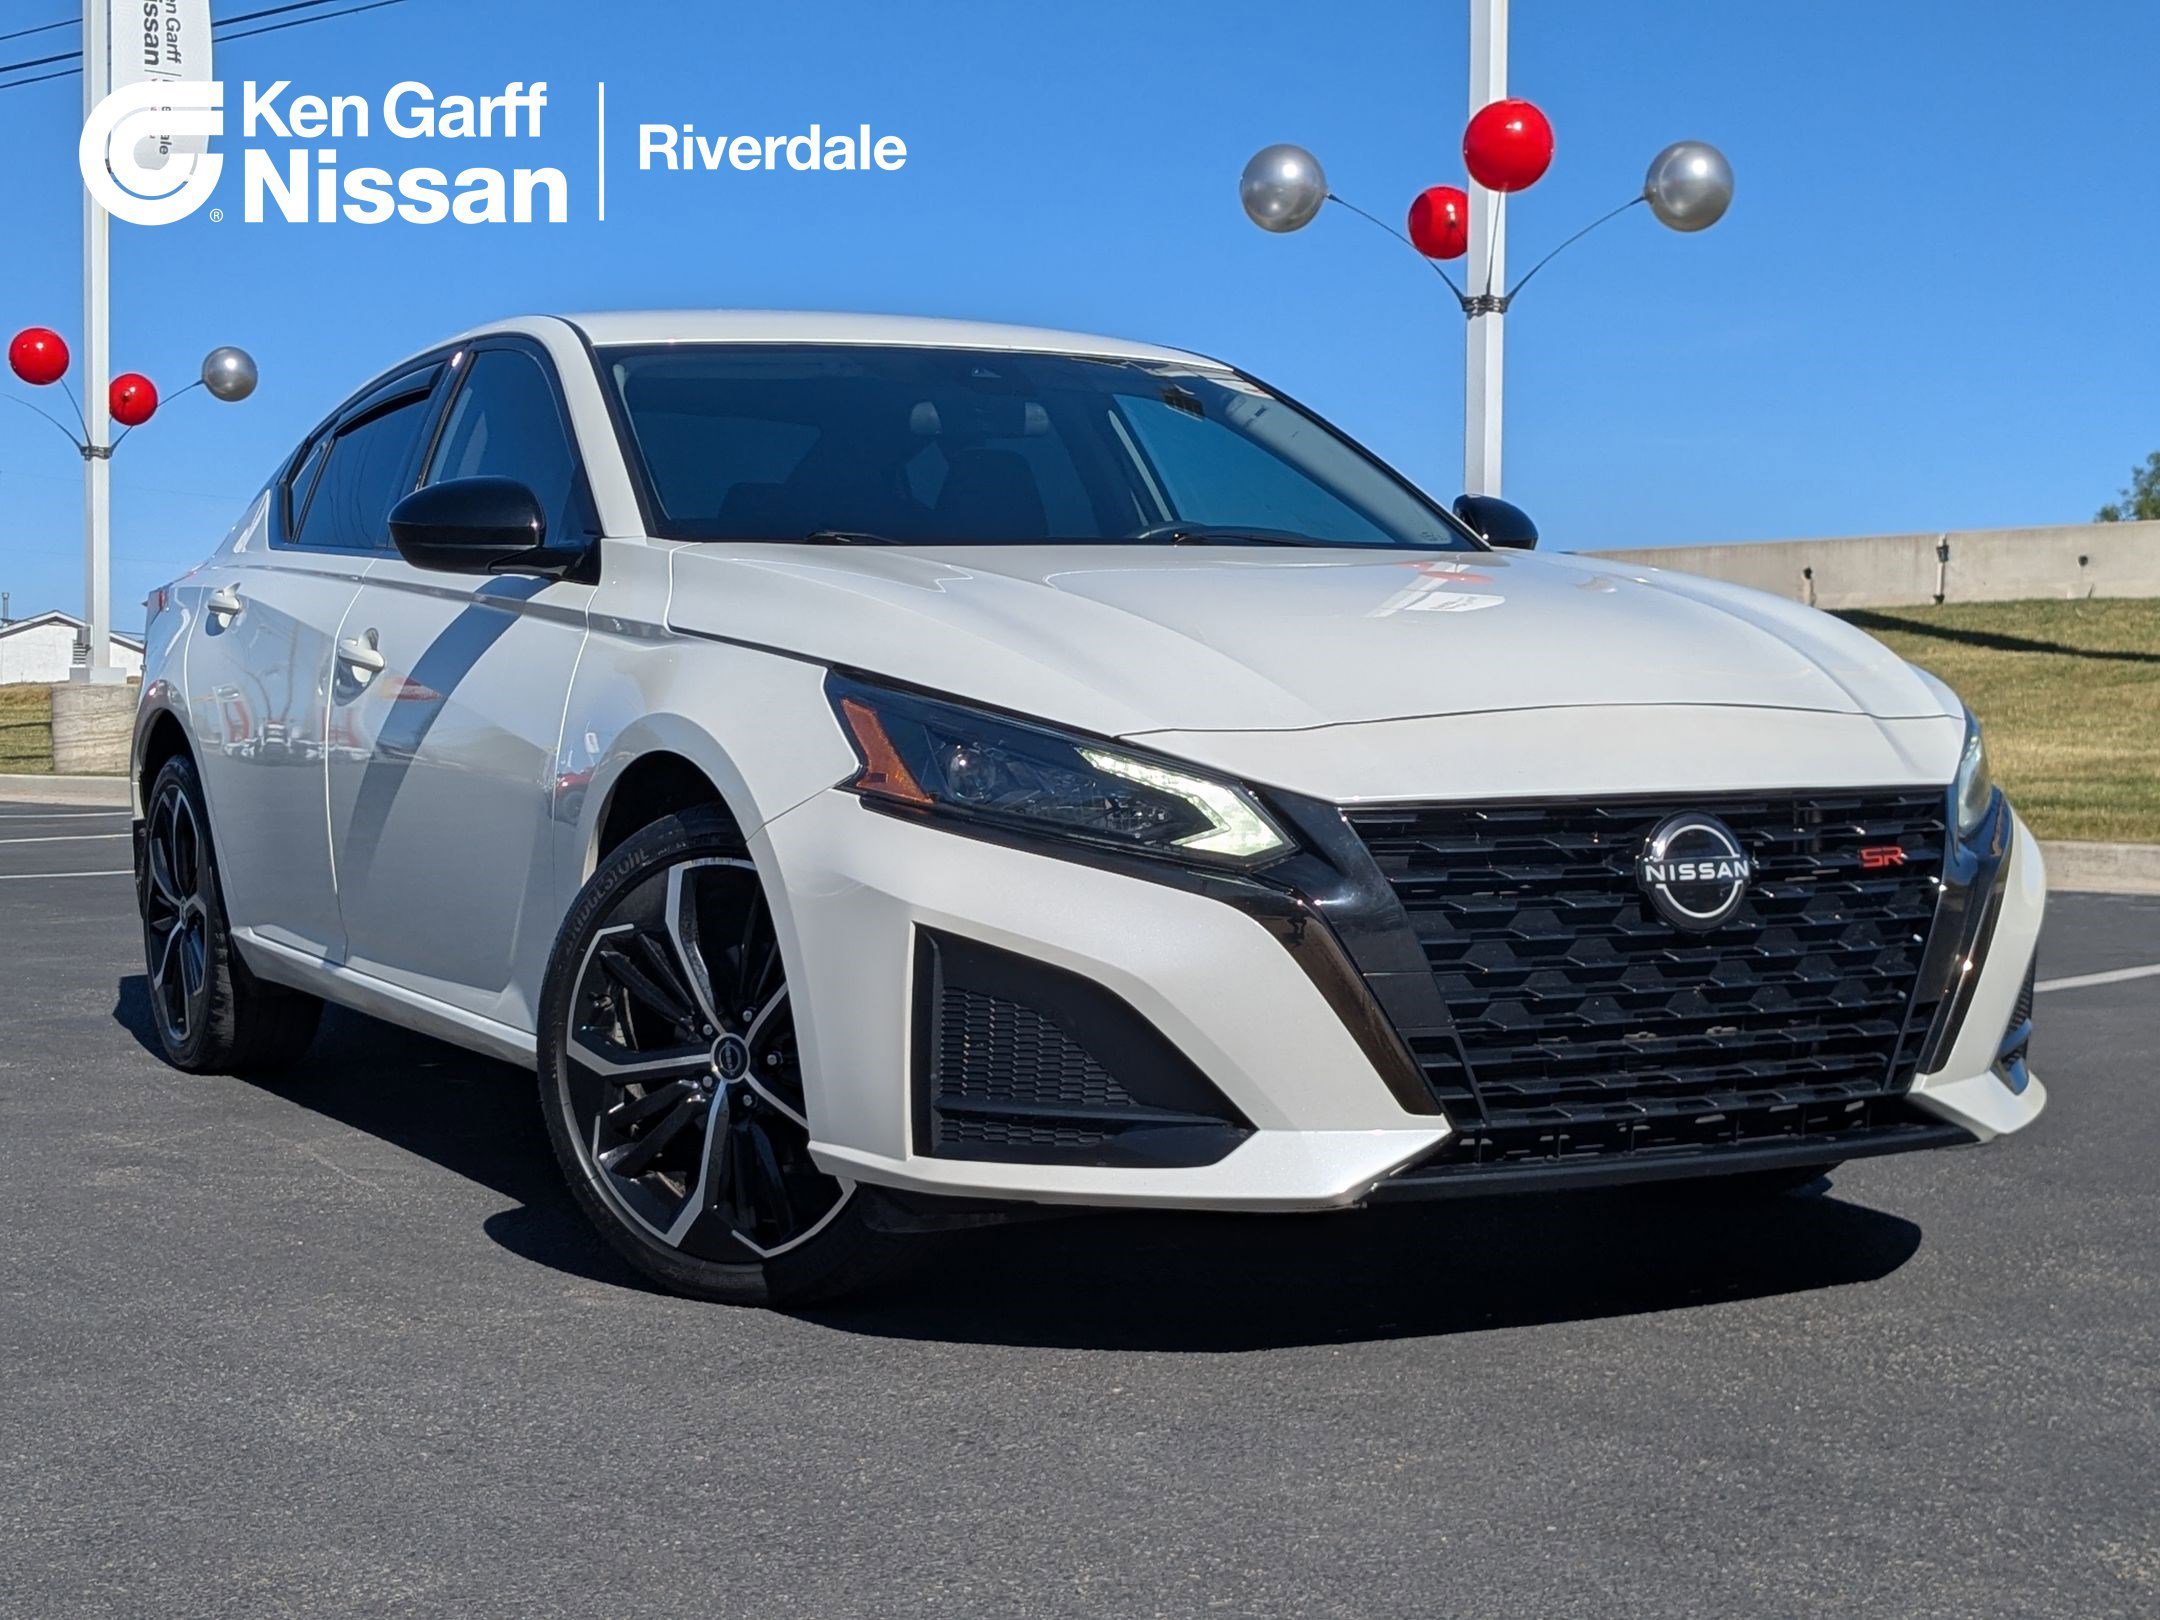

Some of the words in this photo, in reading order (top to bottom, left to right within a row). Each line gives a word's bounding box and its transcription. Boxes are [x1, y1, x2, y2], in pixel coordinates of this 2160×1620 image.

[165, 17, 182, 65] Garff
[1860, 846, 1904, 868] SR
[1645, 860, 1749, 882] NISSAN
